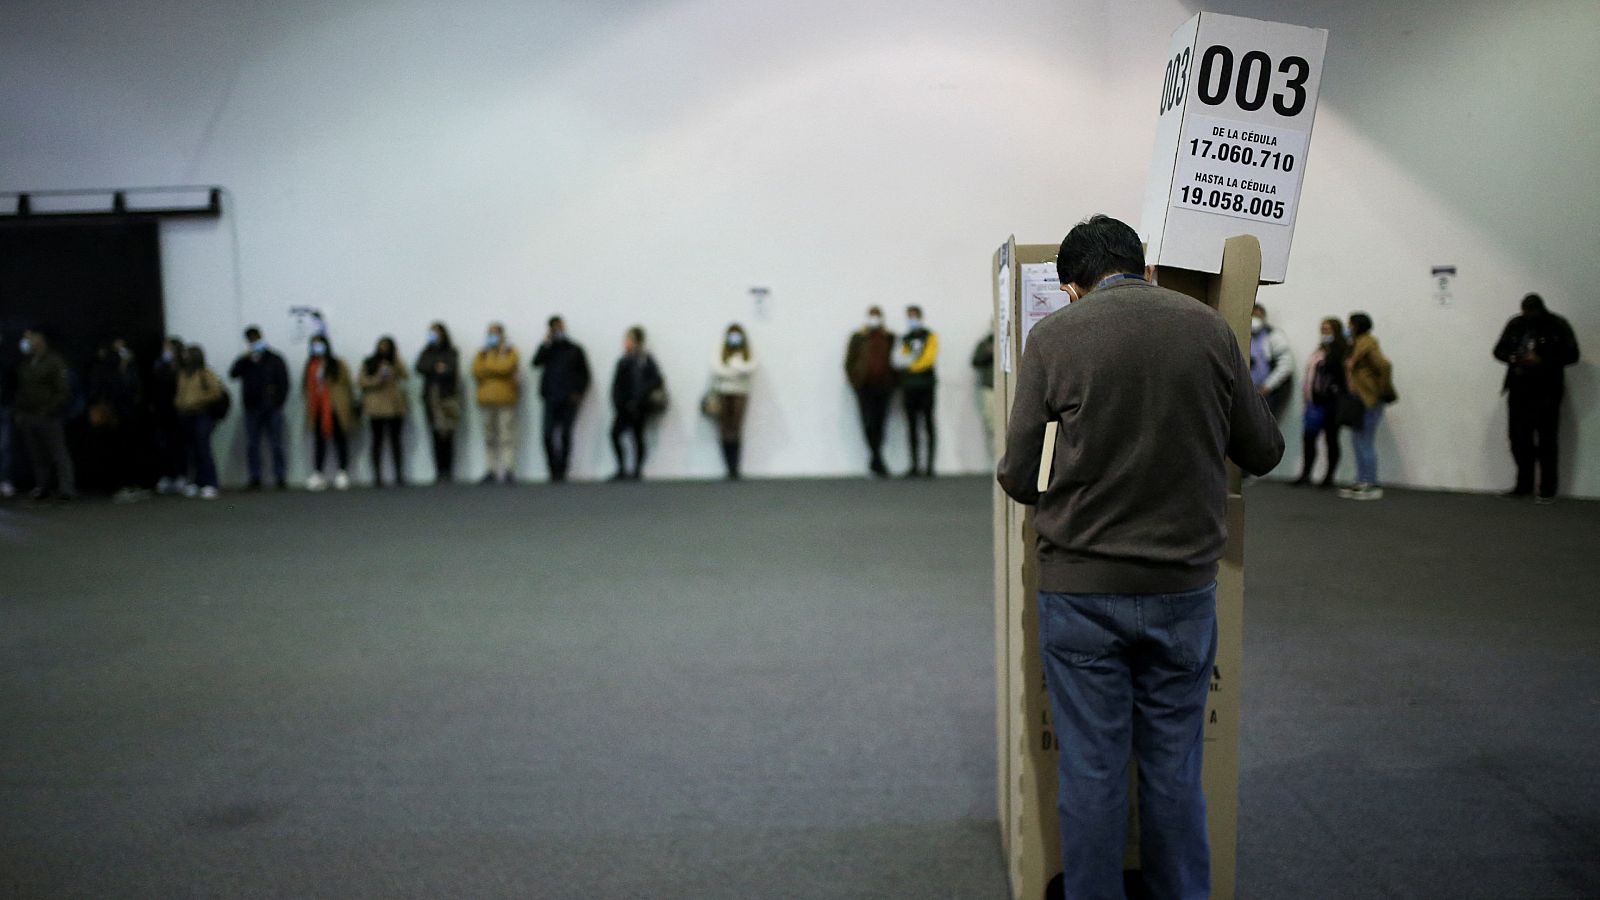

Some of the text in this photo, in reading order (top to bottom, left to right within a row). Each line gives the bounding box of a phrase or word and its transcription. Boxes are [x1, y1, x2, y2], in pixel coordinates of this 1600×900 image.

[1160, 46, 1191, 117] 003
[1197, 44, 1311, 117] 003
[1212, 126, 1278, 146] DE LA CÉDULA
[1189, 138, 1295, 173] 17.060.710
[1194, 172, 1277, 195] HASTA LA CÉDULA
[1181, 185, 1286, 220] 19.058.005
